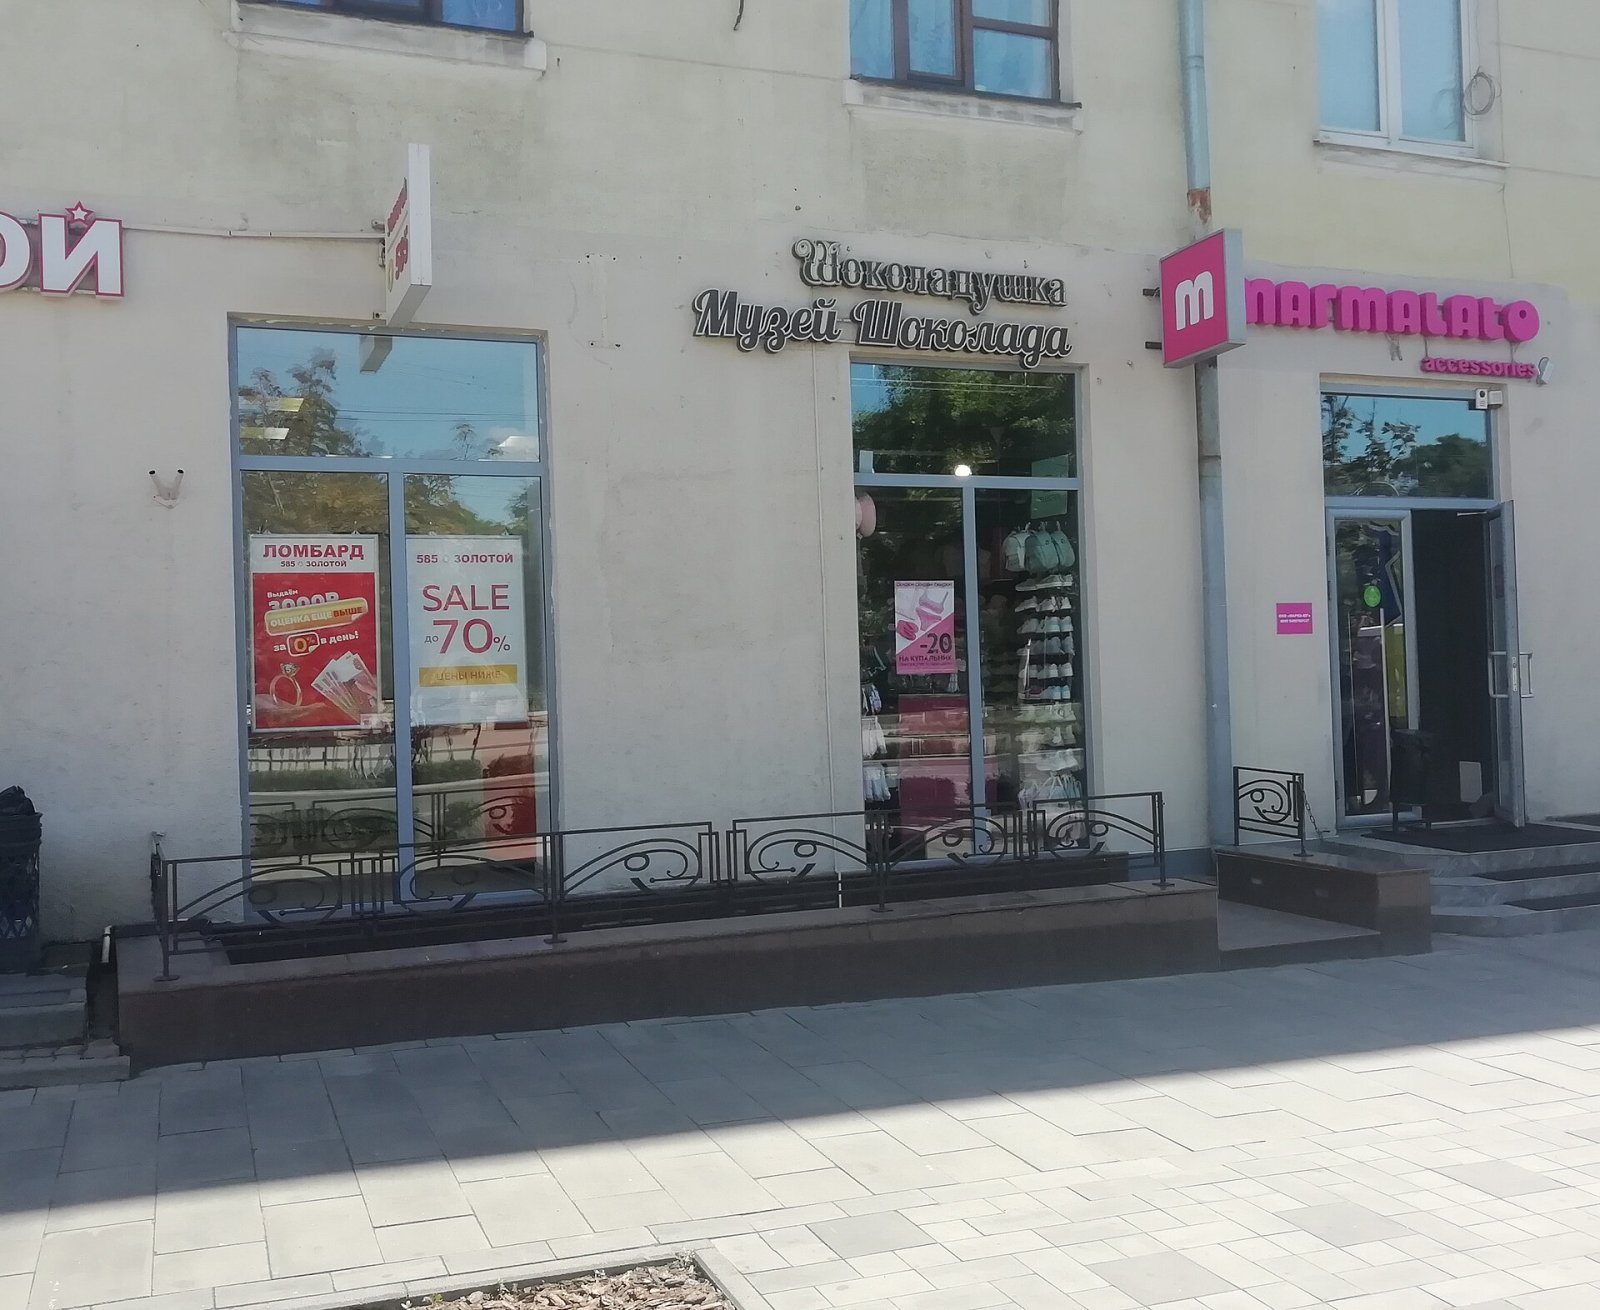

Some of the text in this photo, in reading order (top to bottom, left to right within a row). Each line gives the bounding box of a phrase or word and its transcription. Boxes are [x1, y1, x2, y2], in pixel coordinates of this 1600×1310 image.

[792, 238, 1068, 315] Шоколадушка
[692, 288, 1073, 370] Музей Шоколада
[1421, 355, 1538, 379] accessories
[263, 544, 364, 560] ЛОМБАРД
[416, 552, 514, 563] 585 ЗОЛОТОЙ
[280, 560, 296, 568] 585
[422, 584, 509, 611] SALE
[270, 614, 310, 627] ОЦЕНКА
[333, 606, 363, 617] ВЫШЕ
[273, 644, 287, 652] за
[320, 637, 327, 645] в
[329, 630, 359, 644] день!
[424, 635, 439, 644] до
[436, 671, 467, 681] ЦЕНЫ
